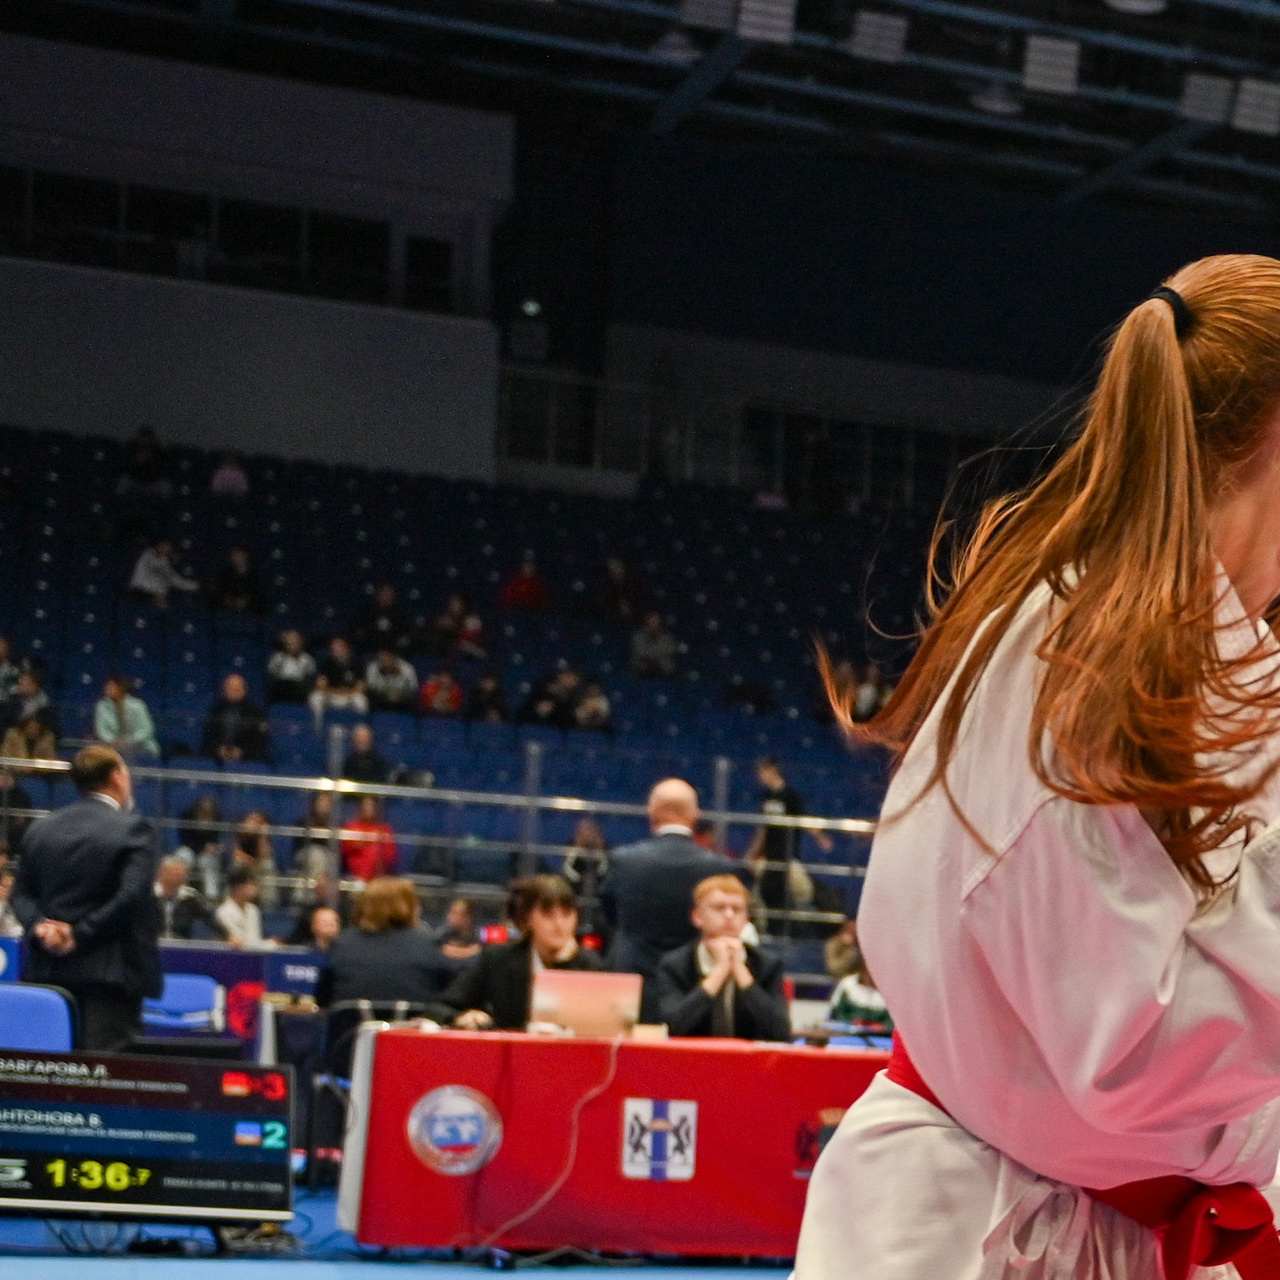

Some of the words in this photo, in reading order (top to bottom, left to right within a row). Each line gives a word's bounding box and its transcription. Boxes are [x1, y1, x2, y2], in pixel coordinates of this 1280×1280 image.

[264, 1073, 287, 1100] 3
[0, 1107, 86, 1127] НТОНОВА
[262, 1120, 288, 1149] 2
